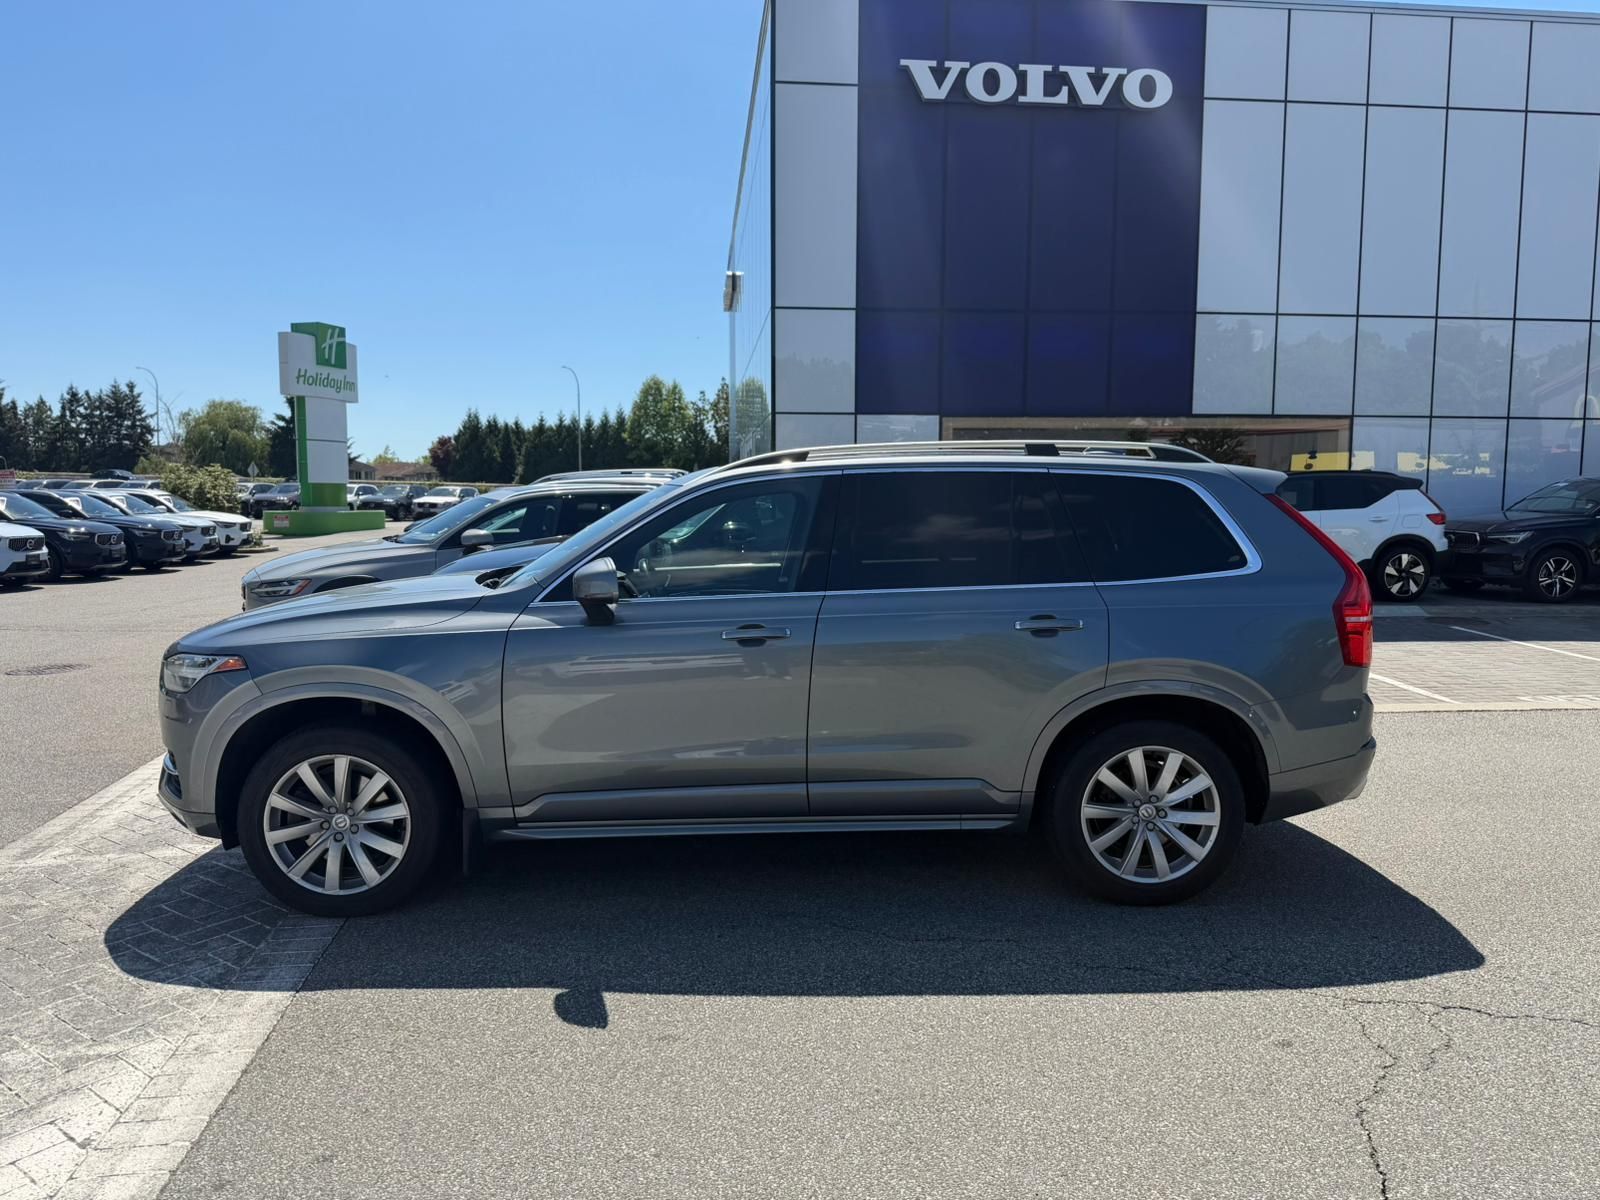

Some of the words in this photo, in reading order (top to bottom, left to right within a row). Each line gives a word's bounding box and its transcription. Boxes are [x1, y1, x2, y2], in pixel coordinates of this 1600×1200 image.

[900, 58, 1174, 110] VOLVO
[296, 368, 342, 393] Holiday
[343, 375, 356, 392] Inn
